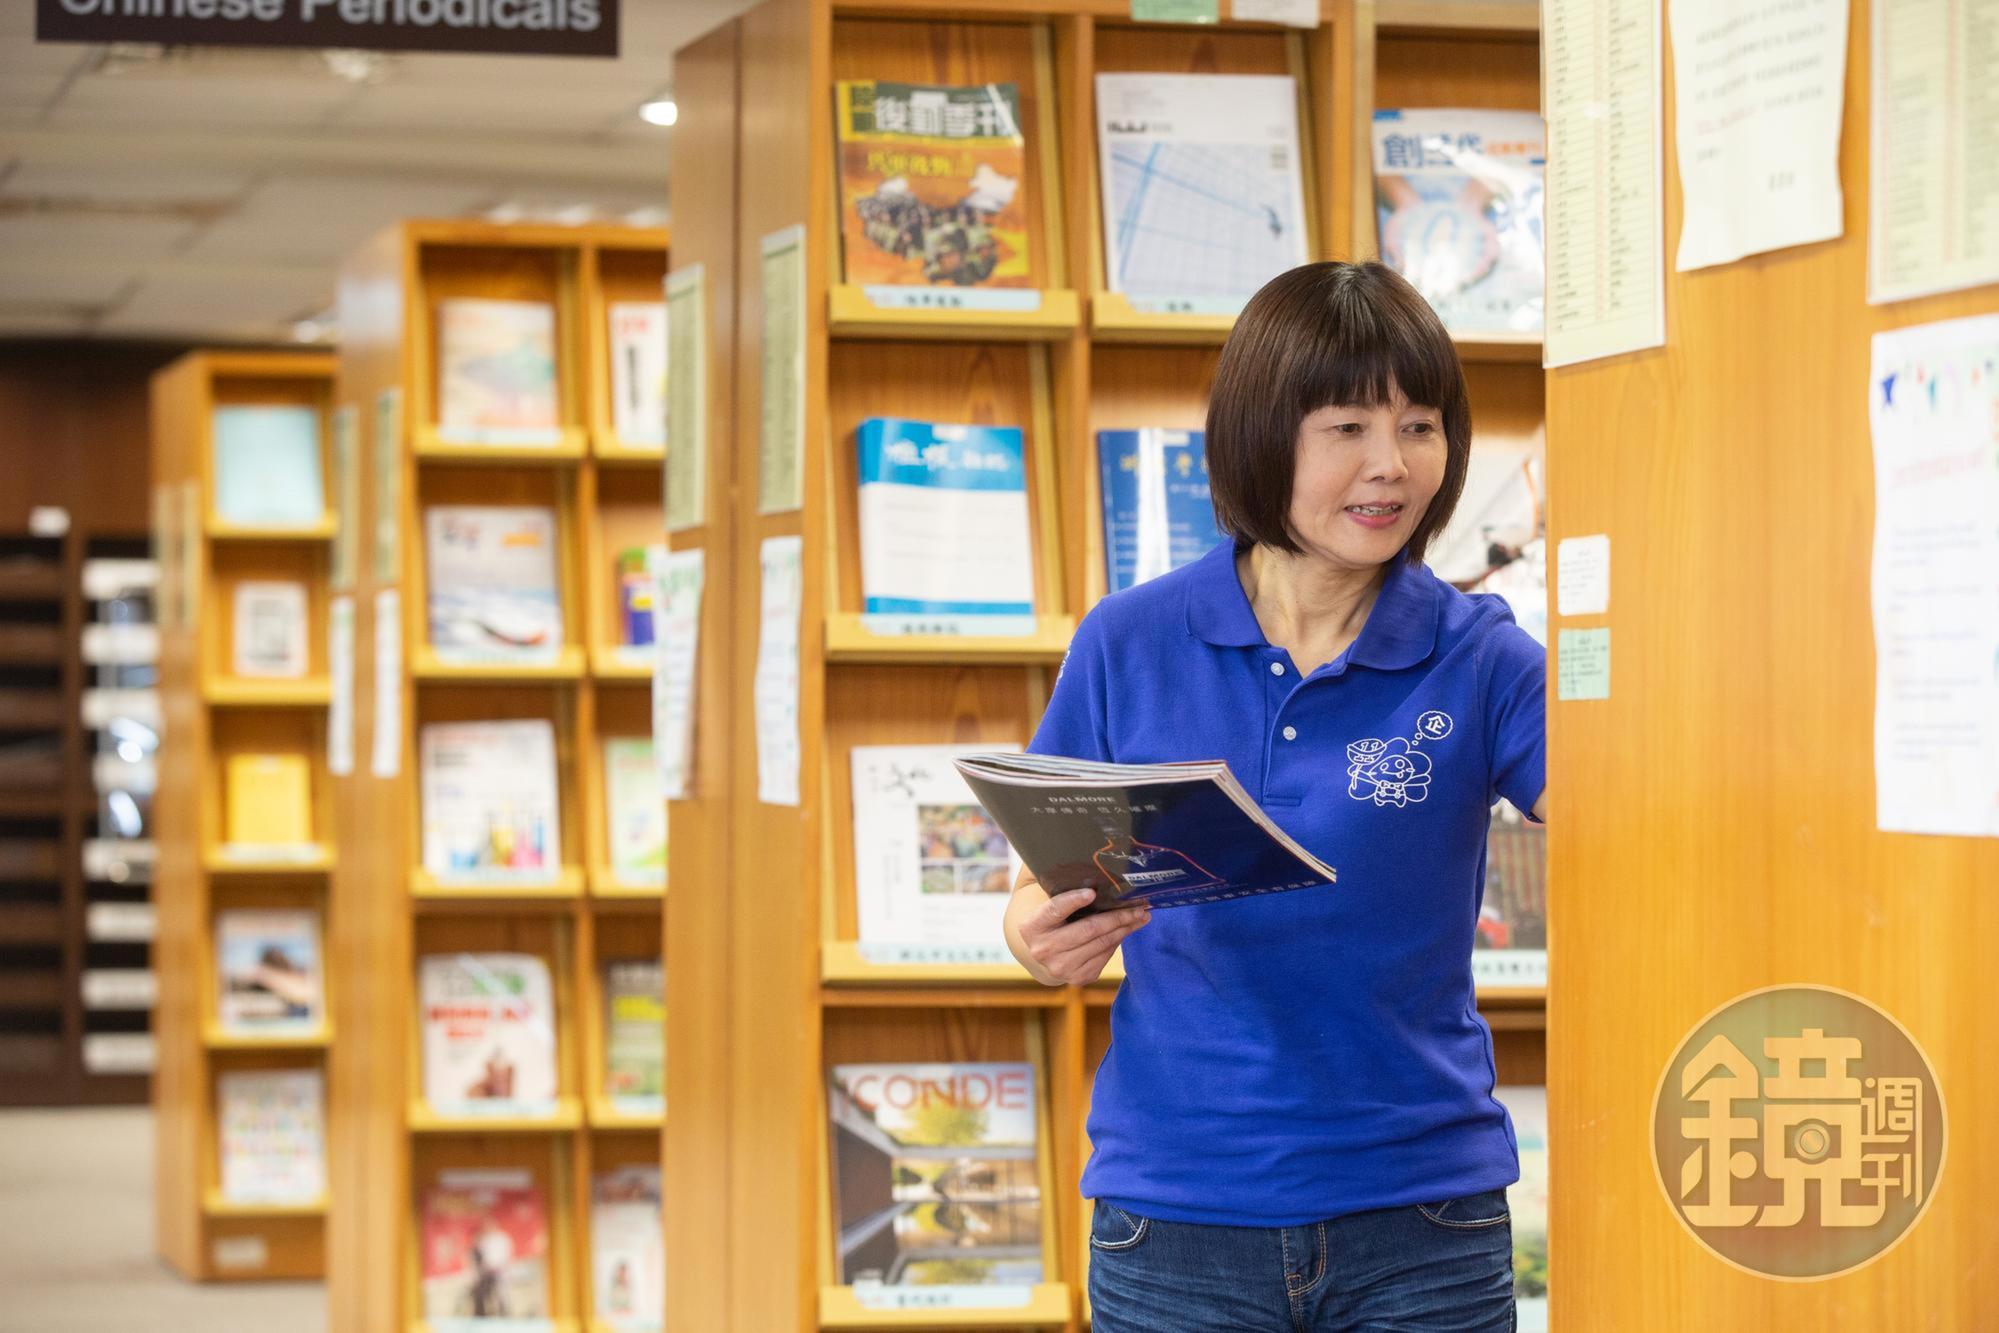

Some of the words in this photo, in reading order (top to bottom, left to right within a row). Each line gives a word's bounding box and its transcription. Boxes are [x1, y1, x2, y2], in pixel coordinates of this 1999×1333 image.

[299, 0, 602, 31] Periodicals
[1426, 716, 1446, 735] 企
[853, 1071, 1027, 1112] CONDE
